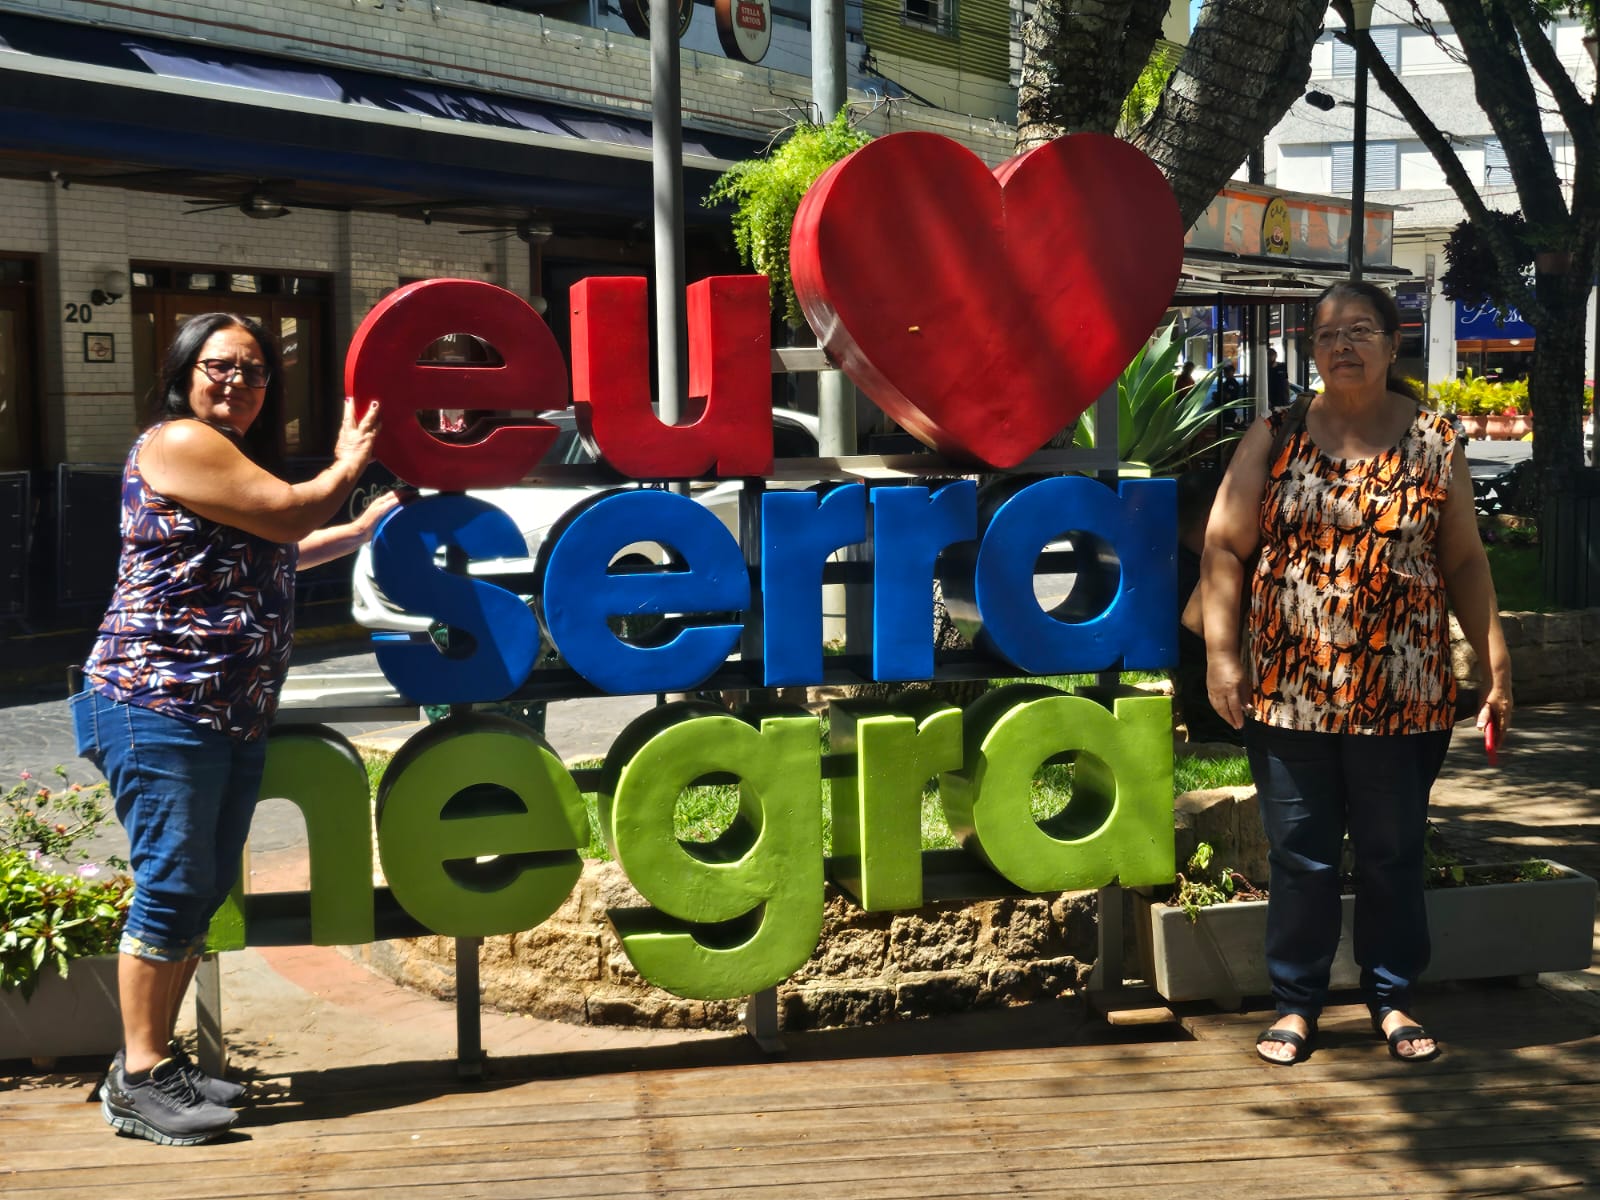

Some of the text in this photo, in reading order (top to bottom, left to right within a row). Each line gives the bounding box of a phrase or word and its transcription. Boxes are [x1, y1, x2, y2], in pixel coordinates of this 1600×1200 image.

[741, 6, 760, 17] STELLA
[742, 15, 761, 26] ARTOIS
[65, 303, 92, 323] 20
[345, 275, 774, 490] eu
[371, 476, 1179, 704] serra
[207, 694, 1176, 1000] negra
